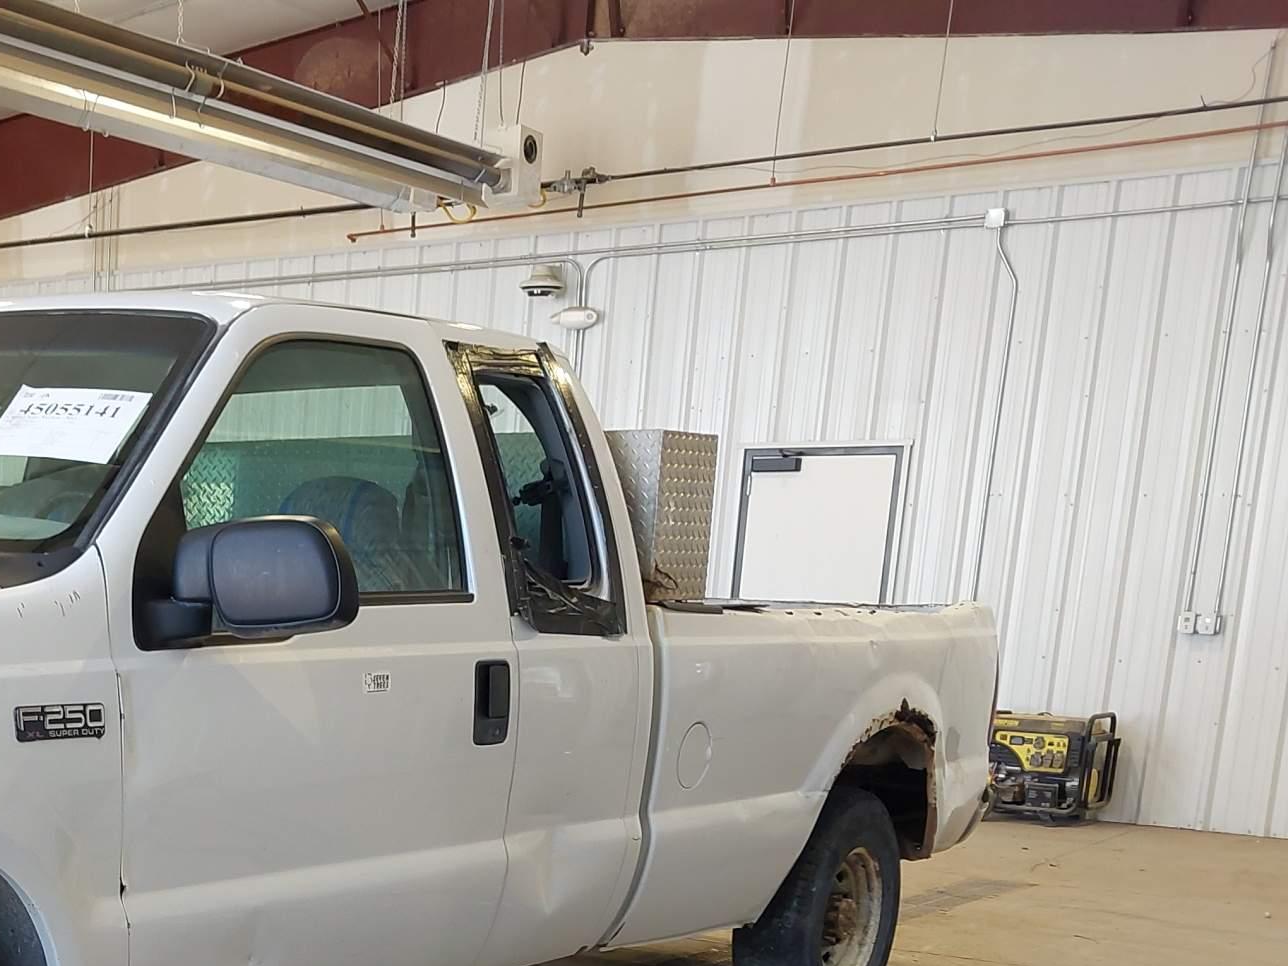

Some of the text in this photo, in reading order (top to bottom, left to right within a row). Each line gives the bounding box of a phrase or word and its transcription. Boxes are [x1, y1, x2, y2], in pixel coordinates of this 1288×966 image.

[19, 402, 121, 419] 45055141
[48, 728, 79, 737] SUPER
[81, 727, 105, 736] DUTY
